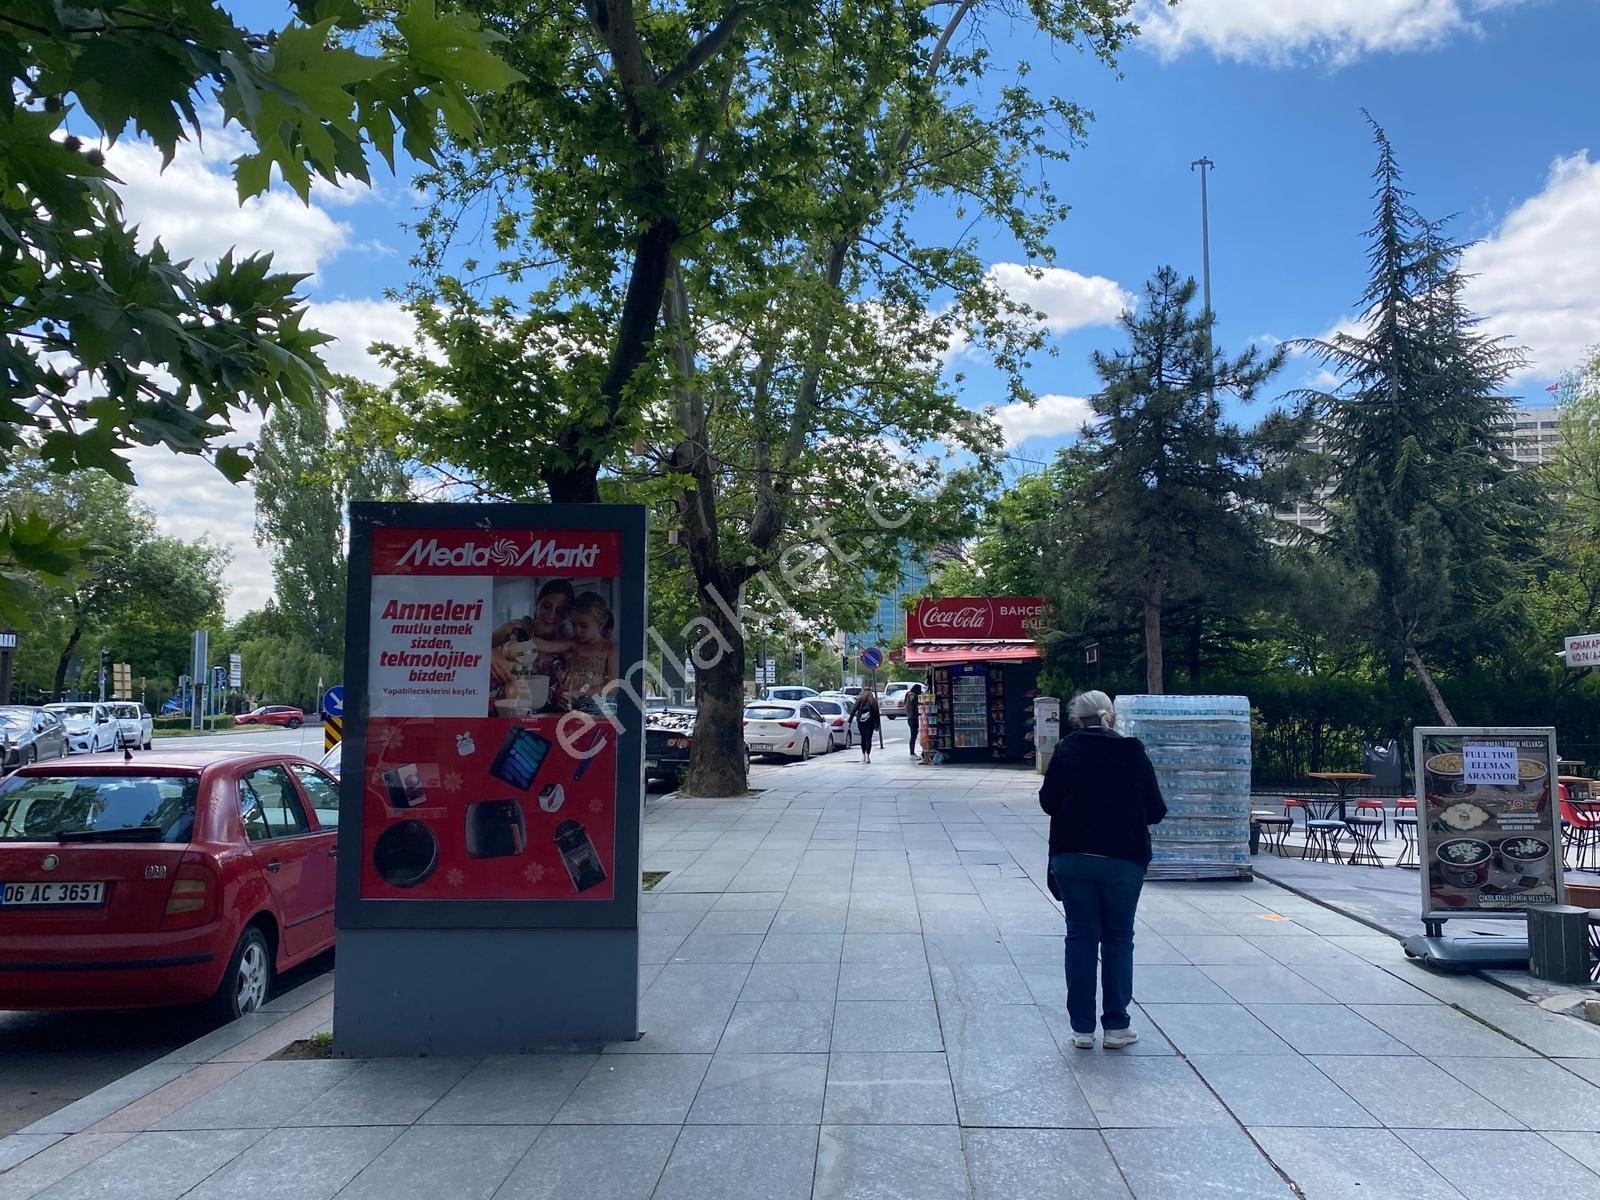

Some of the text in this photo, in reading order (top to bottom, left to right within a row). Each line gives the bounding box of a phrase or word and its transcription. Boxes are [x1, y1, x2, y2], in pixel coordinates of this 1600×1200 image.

[396, 539, 600, 568] Media Markt
[381, 599, 483, 620] Anneleri
[922, 606, 988, 628] Coca-Cola
[391, 623, 473, 635] mutlu etmek
[410, 637, 453, 650] sizden,
[380, 651, 481, 669] teknolojiler
[409, 669, 456, 681] bizden!
[383, 687, 451, 696] Yapabileceklerini
[1465, 751, 1516, 759] FULL TIME
[1471, 761, 1511, 769] ELEMAN
[1466, 772, 1517, 780] ARANIYOR
[4, 884, 99, 902] 06 AC 3651
